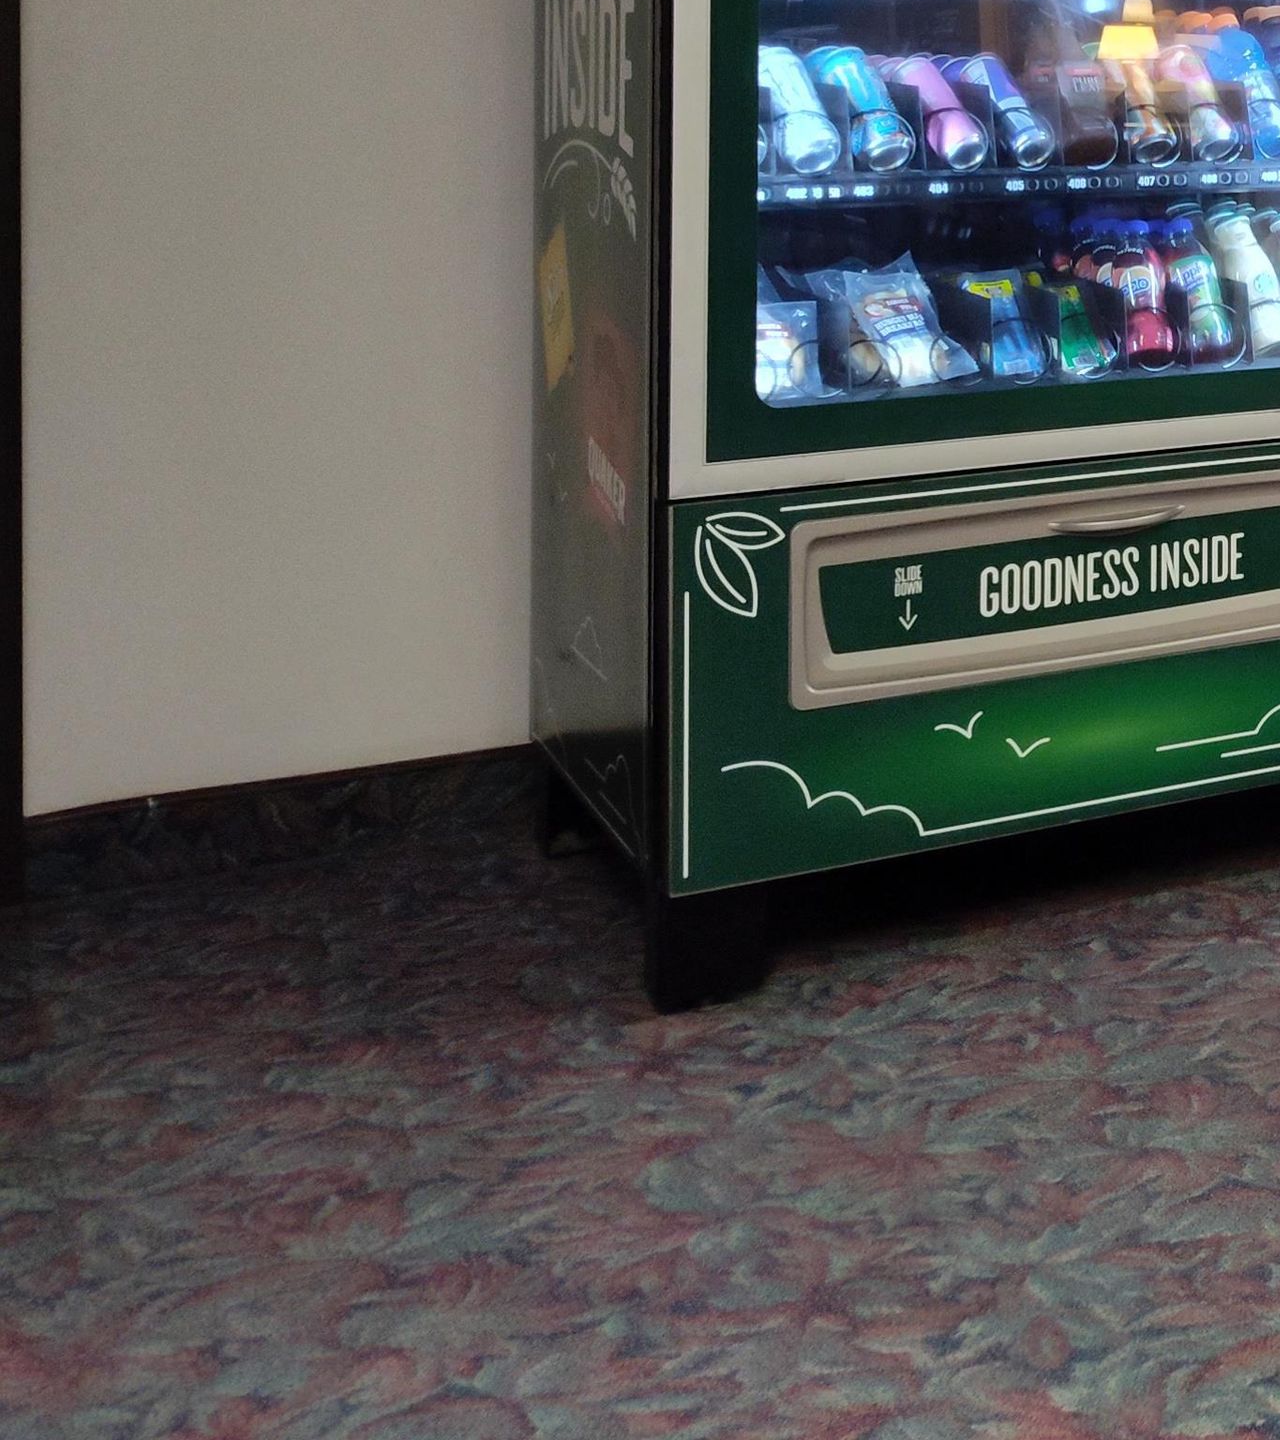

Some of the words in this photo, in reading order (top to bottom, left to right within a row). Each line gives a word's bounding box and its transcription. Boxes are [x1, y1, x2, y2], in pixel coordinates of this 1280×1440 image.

[1005, 180, 1025, 192] 405
[894, 564, 923, 582] SLIDE
[978, 544, 1142, 618] GOODNESS
[1149, 532, 1245, 593] INSIDE
[894, 578, 923, 596] DOWN
